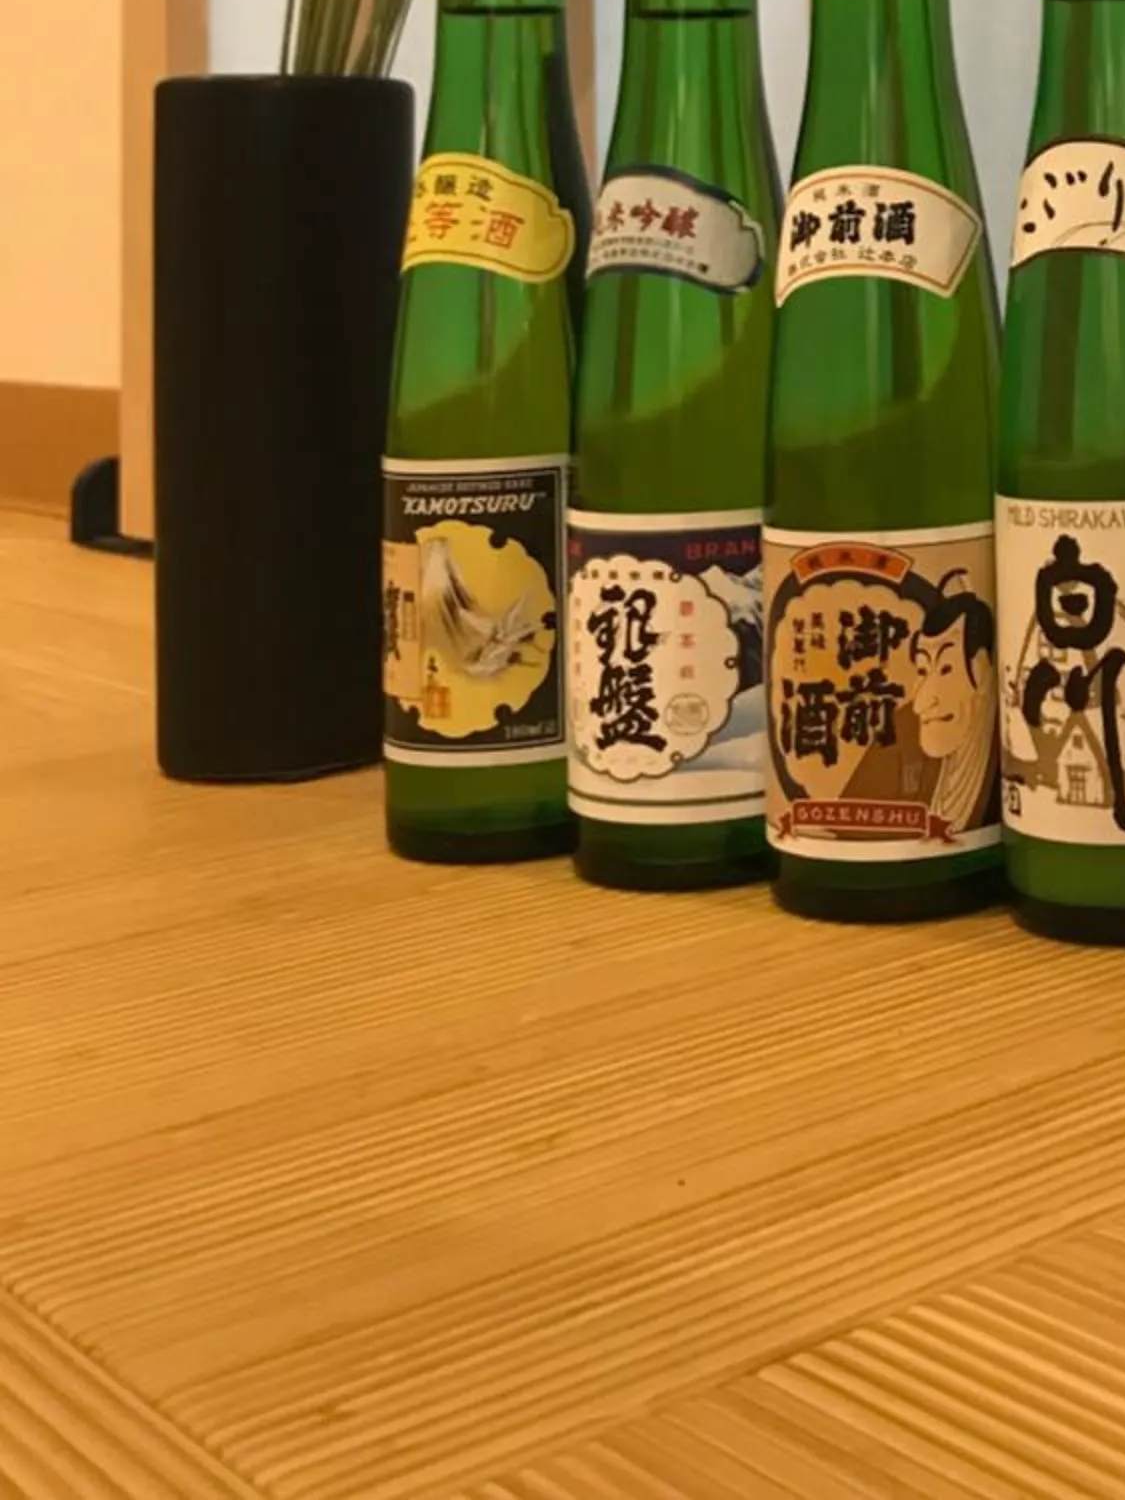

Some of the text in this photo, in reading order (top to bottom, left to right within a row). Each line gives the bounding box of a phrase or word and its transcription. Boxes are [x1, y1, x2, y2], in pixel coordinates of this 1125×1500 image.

[411, 202, 526, 249] 等酒
[790, 199, 917, 253] 御前酒
[587, 585, 668, 750] 銀盤
[797, 804, 921, 825] GOZENSHU
